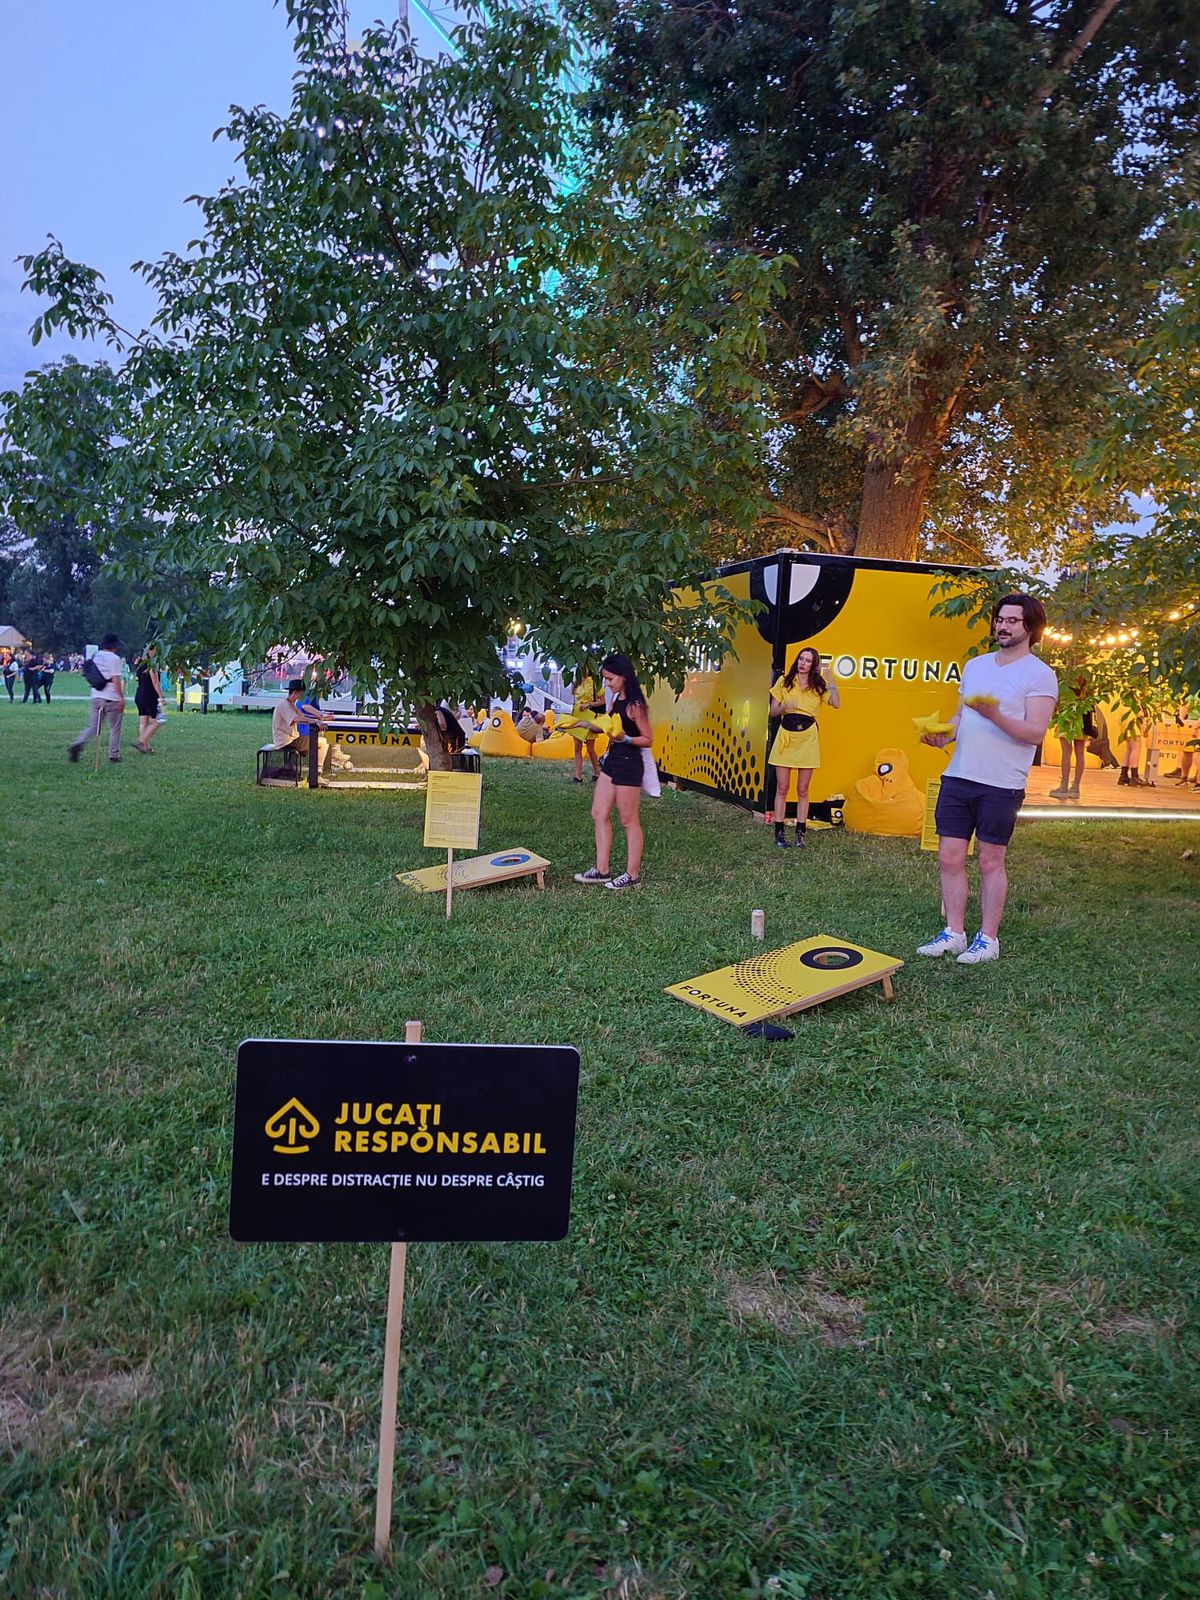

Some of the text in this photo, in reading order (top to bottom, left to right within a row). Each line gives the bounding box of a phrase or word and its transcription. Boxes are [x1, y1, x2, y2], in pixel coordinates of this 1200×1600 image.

[819, 654, 962, 684] FORTUNA
[335, 733, 411, 746] FORTUNA
[680, 985, 748, 1018] FORTUNA
[334, 1131, 547, 1154] RESPONSABIL
[261, 1173, 270, 1187] E
[274, 1173, 327, 1187] DESPRE
[416, 1174, 437, 1187] NU
[441, 1174, 493, 1188] DESPRE
